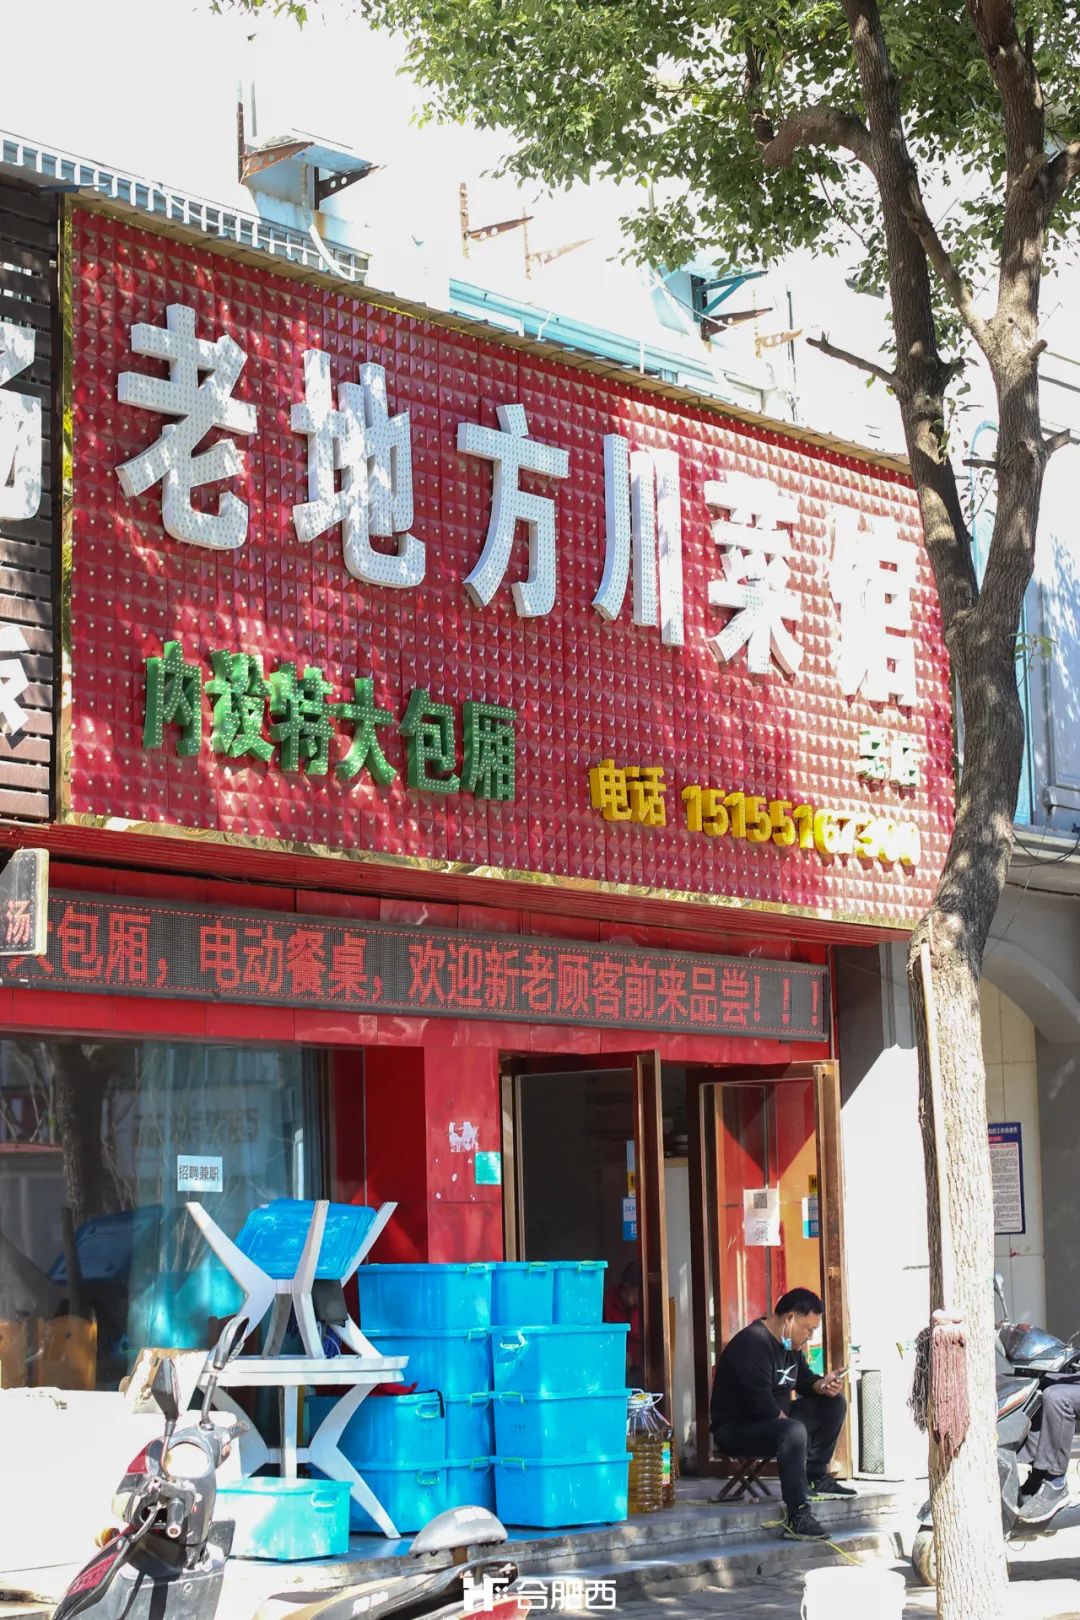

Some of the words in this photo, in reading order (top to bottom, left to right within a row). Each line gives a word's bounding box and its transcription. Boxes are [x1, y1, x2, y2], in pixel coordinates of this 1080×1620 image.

[115, 303, 917, 707] 老地方川菜馆
[143, 640, 517, 801] 内设特大包厢
[589, 759, 667, 826] 电话
[178, 1165, 220, 1181] 招聘兼职
